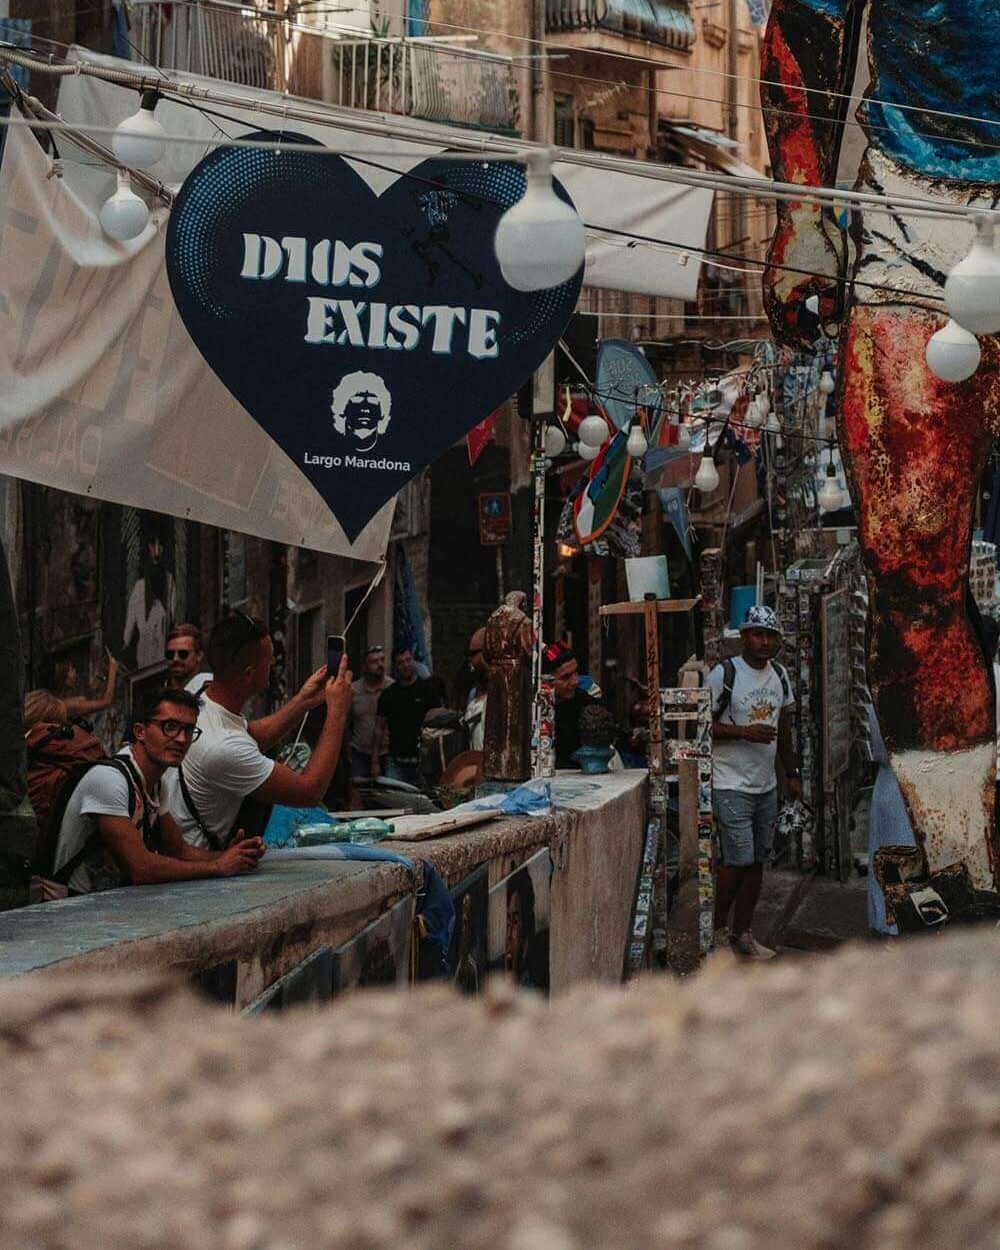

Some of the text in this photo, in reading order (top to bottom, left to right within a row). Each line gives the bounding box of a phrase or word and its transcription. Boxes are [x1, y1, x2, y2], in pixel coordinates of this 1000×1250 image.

[304, 296, 501, 360] EXISTE
[304, 452, 411, 471] Largo Maradona
